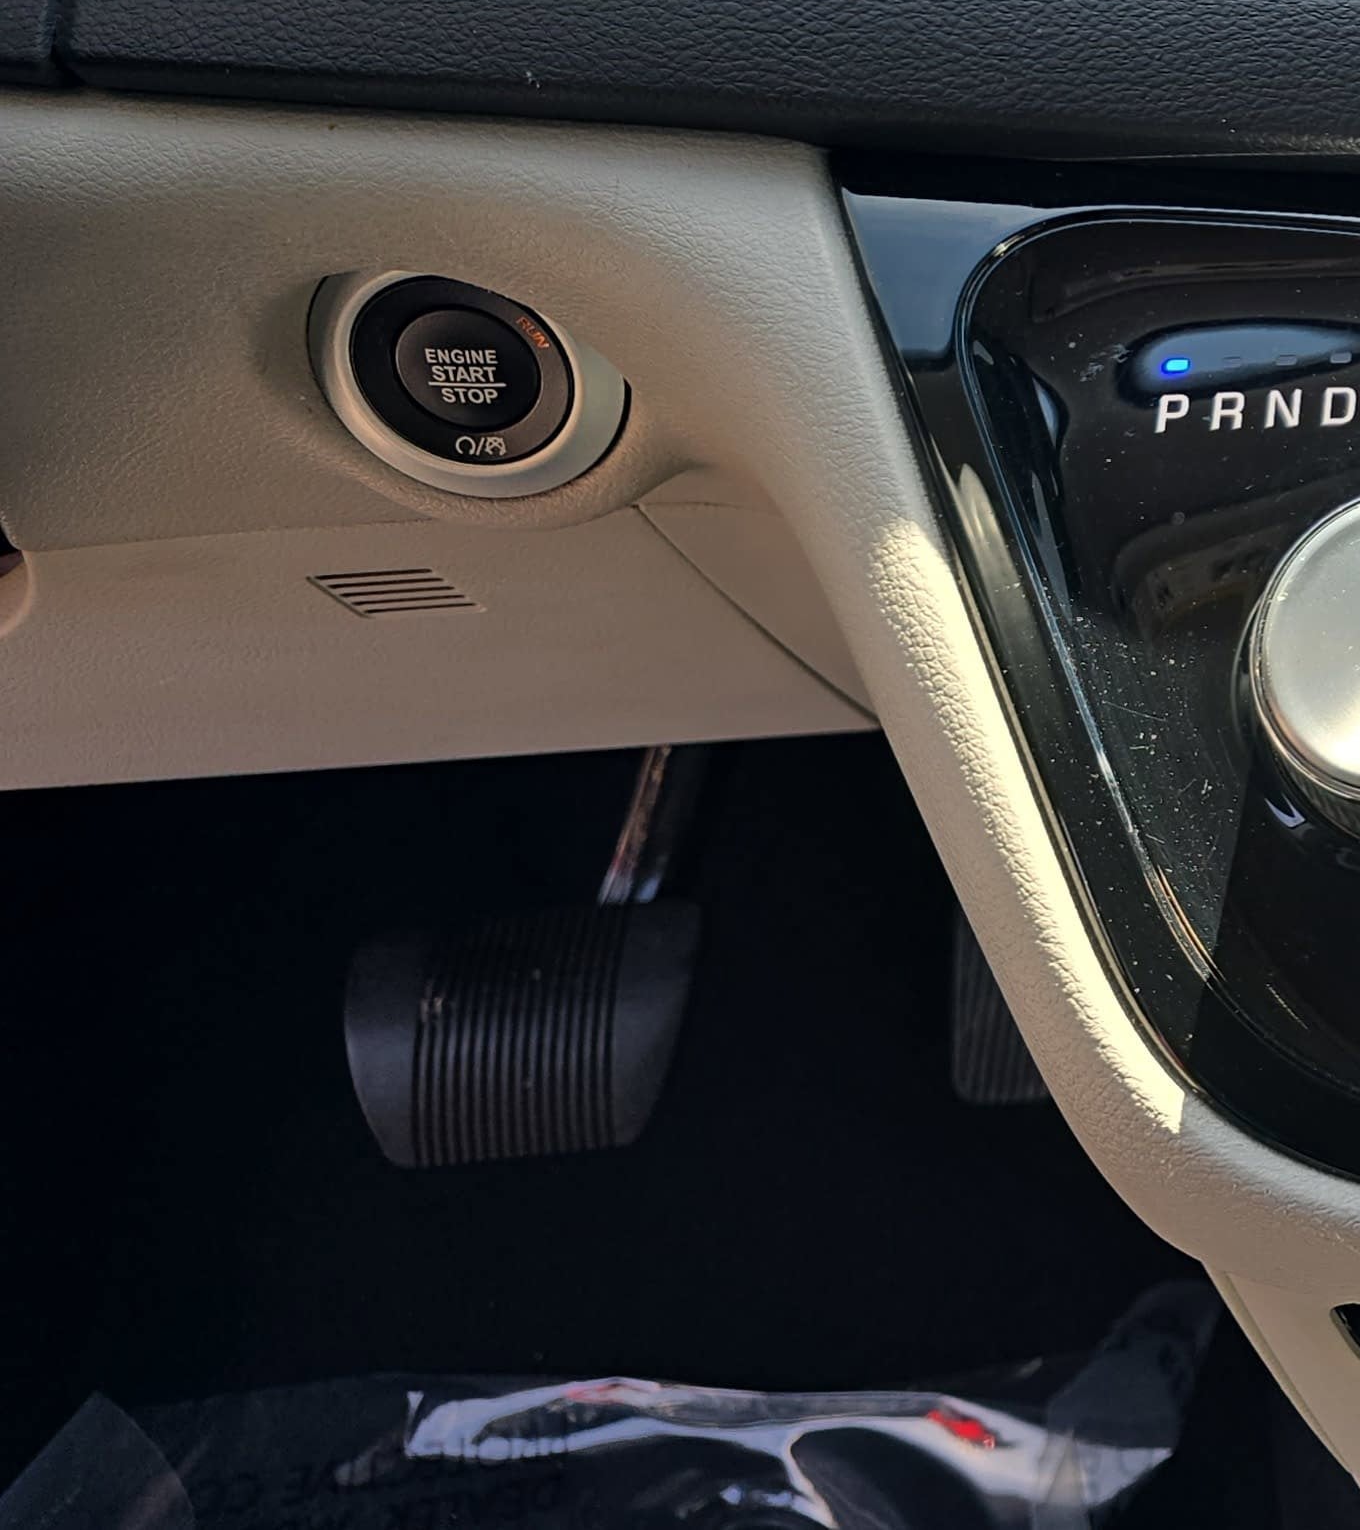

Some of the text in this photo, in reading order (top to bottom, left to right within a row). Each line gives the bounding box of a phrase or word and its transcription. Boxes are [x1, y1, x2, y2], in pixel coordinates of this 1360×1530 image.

[424, 347, 498, 364] ENGINE
[431, 365, 497, 383] START
[441, 387, 498, 404] STOP
